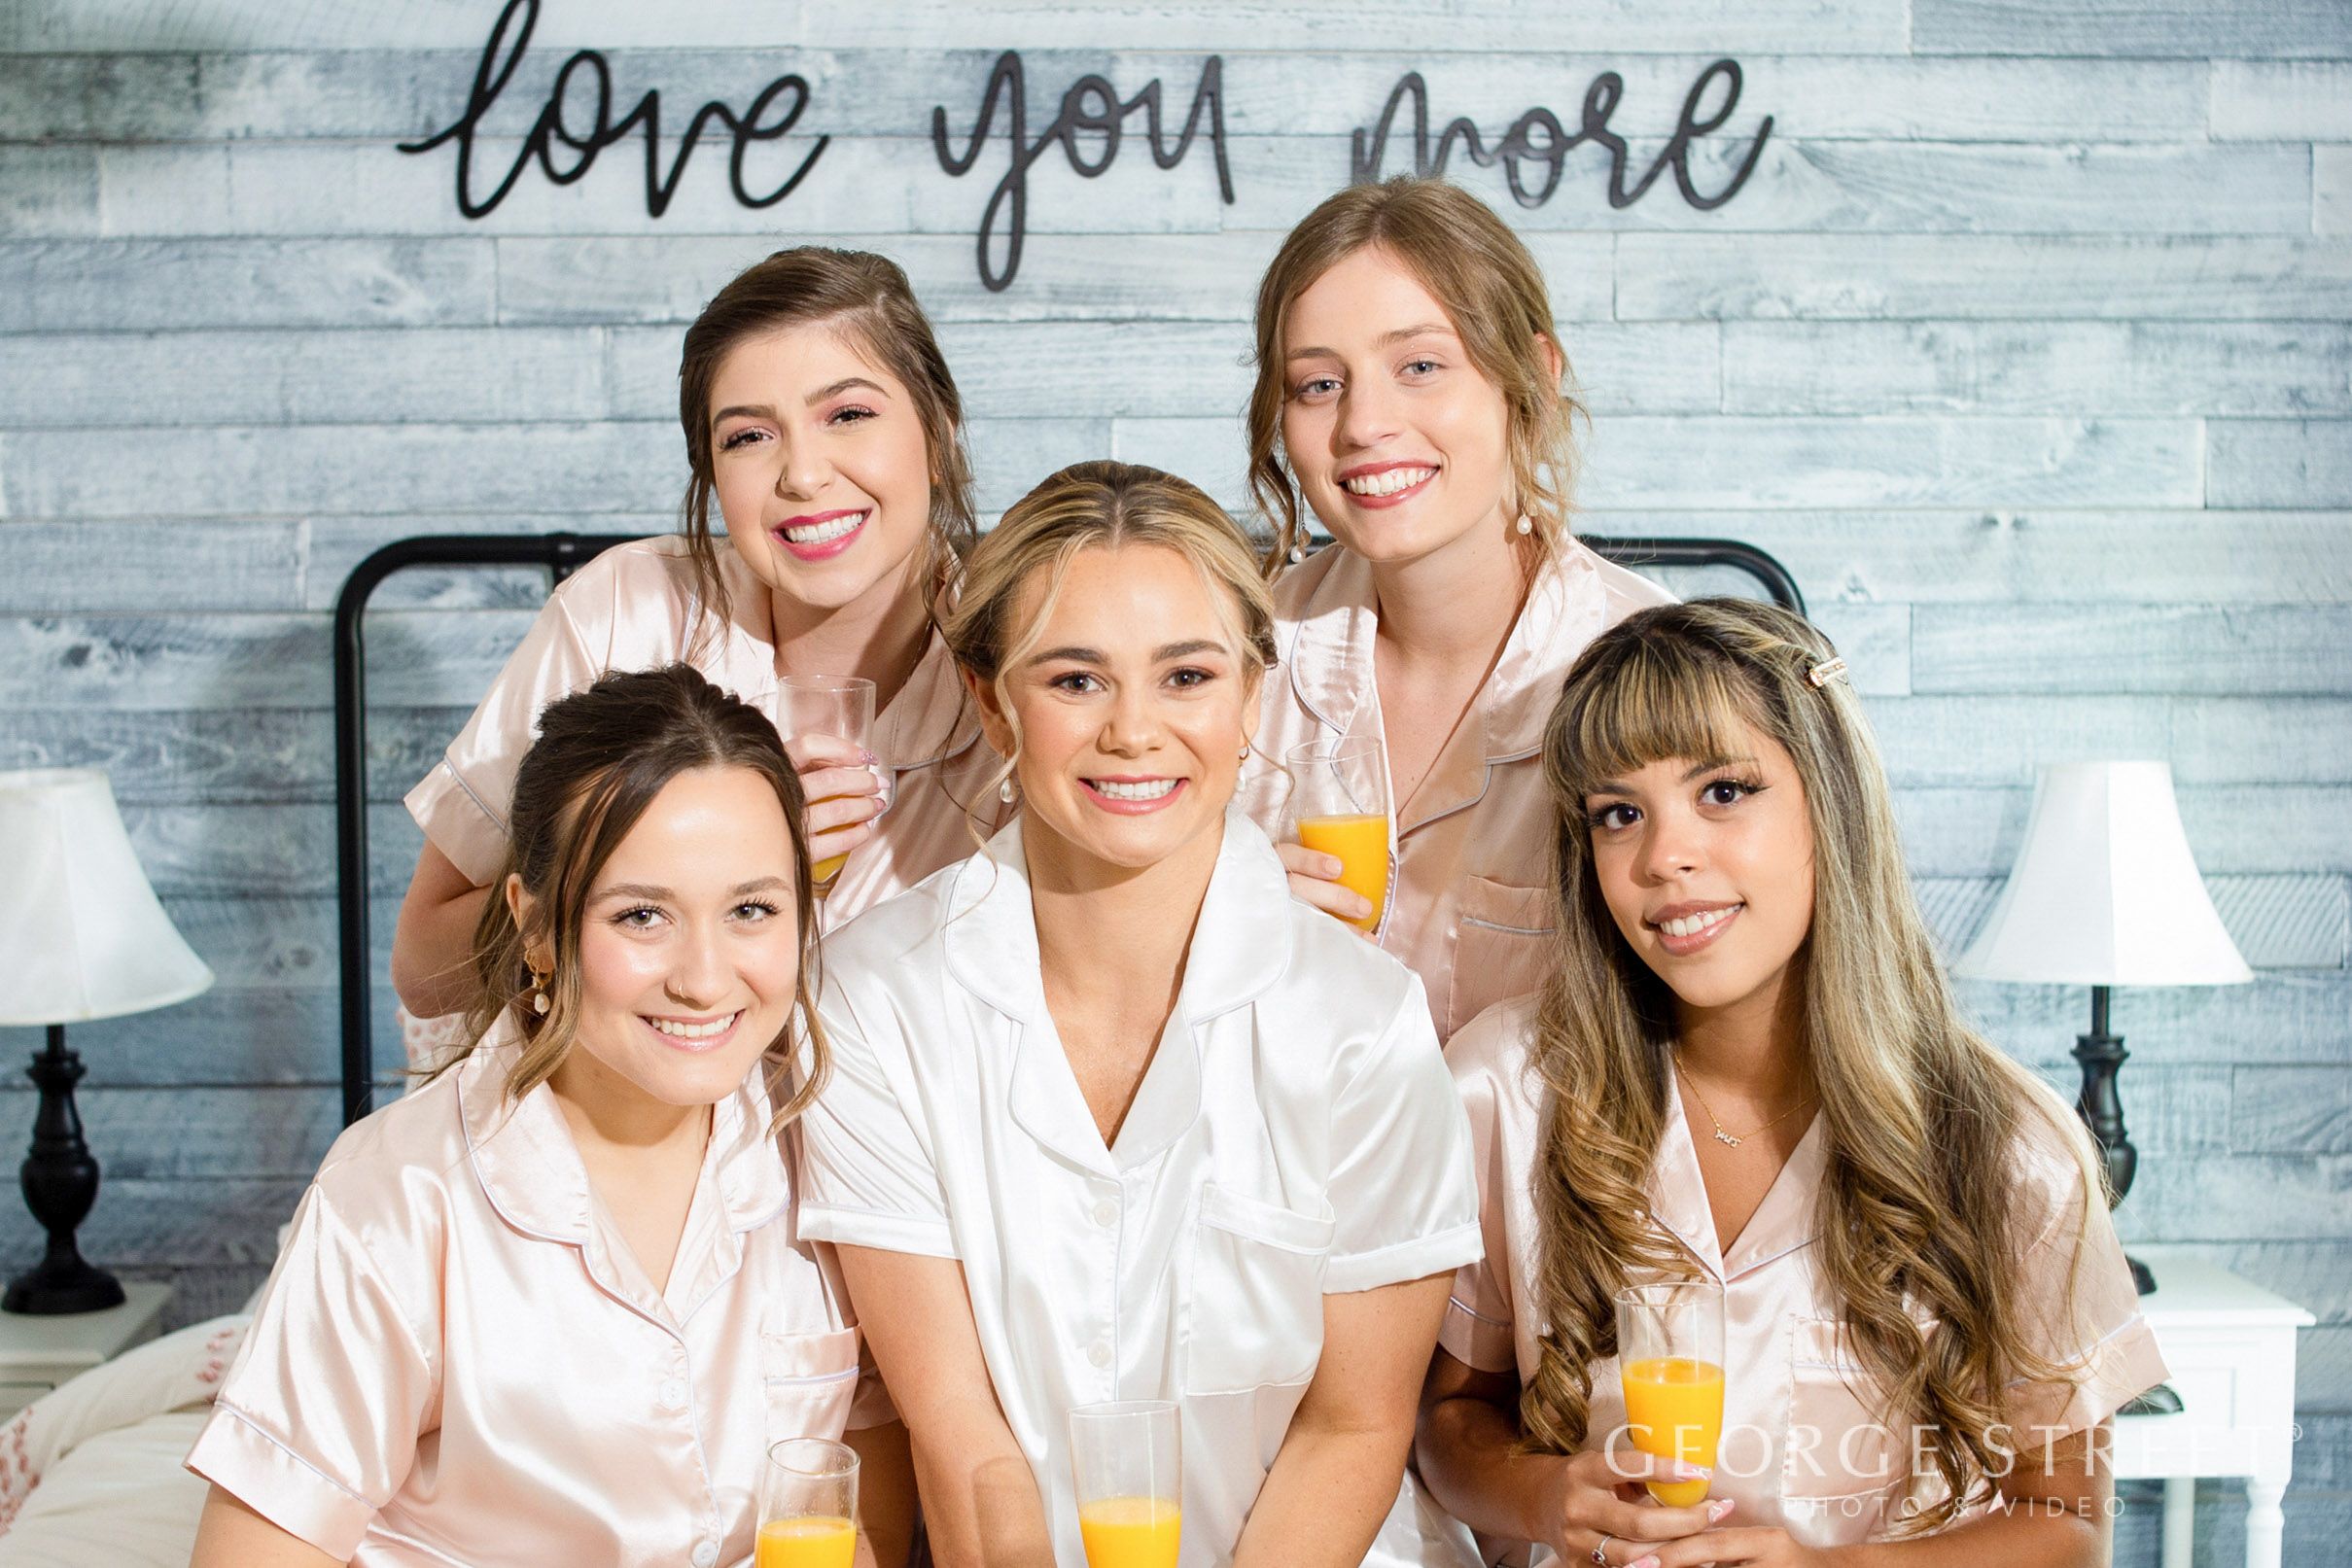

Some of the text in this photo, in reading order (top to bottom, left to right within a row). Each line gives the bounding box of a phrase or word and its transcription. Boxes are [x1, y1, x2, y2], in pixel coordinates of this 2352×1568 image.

[397, 0, 1774, 292] love you more
